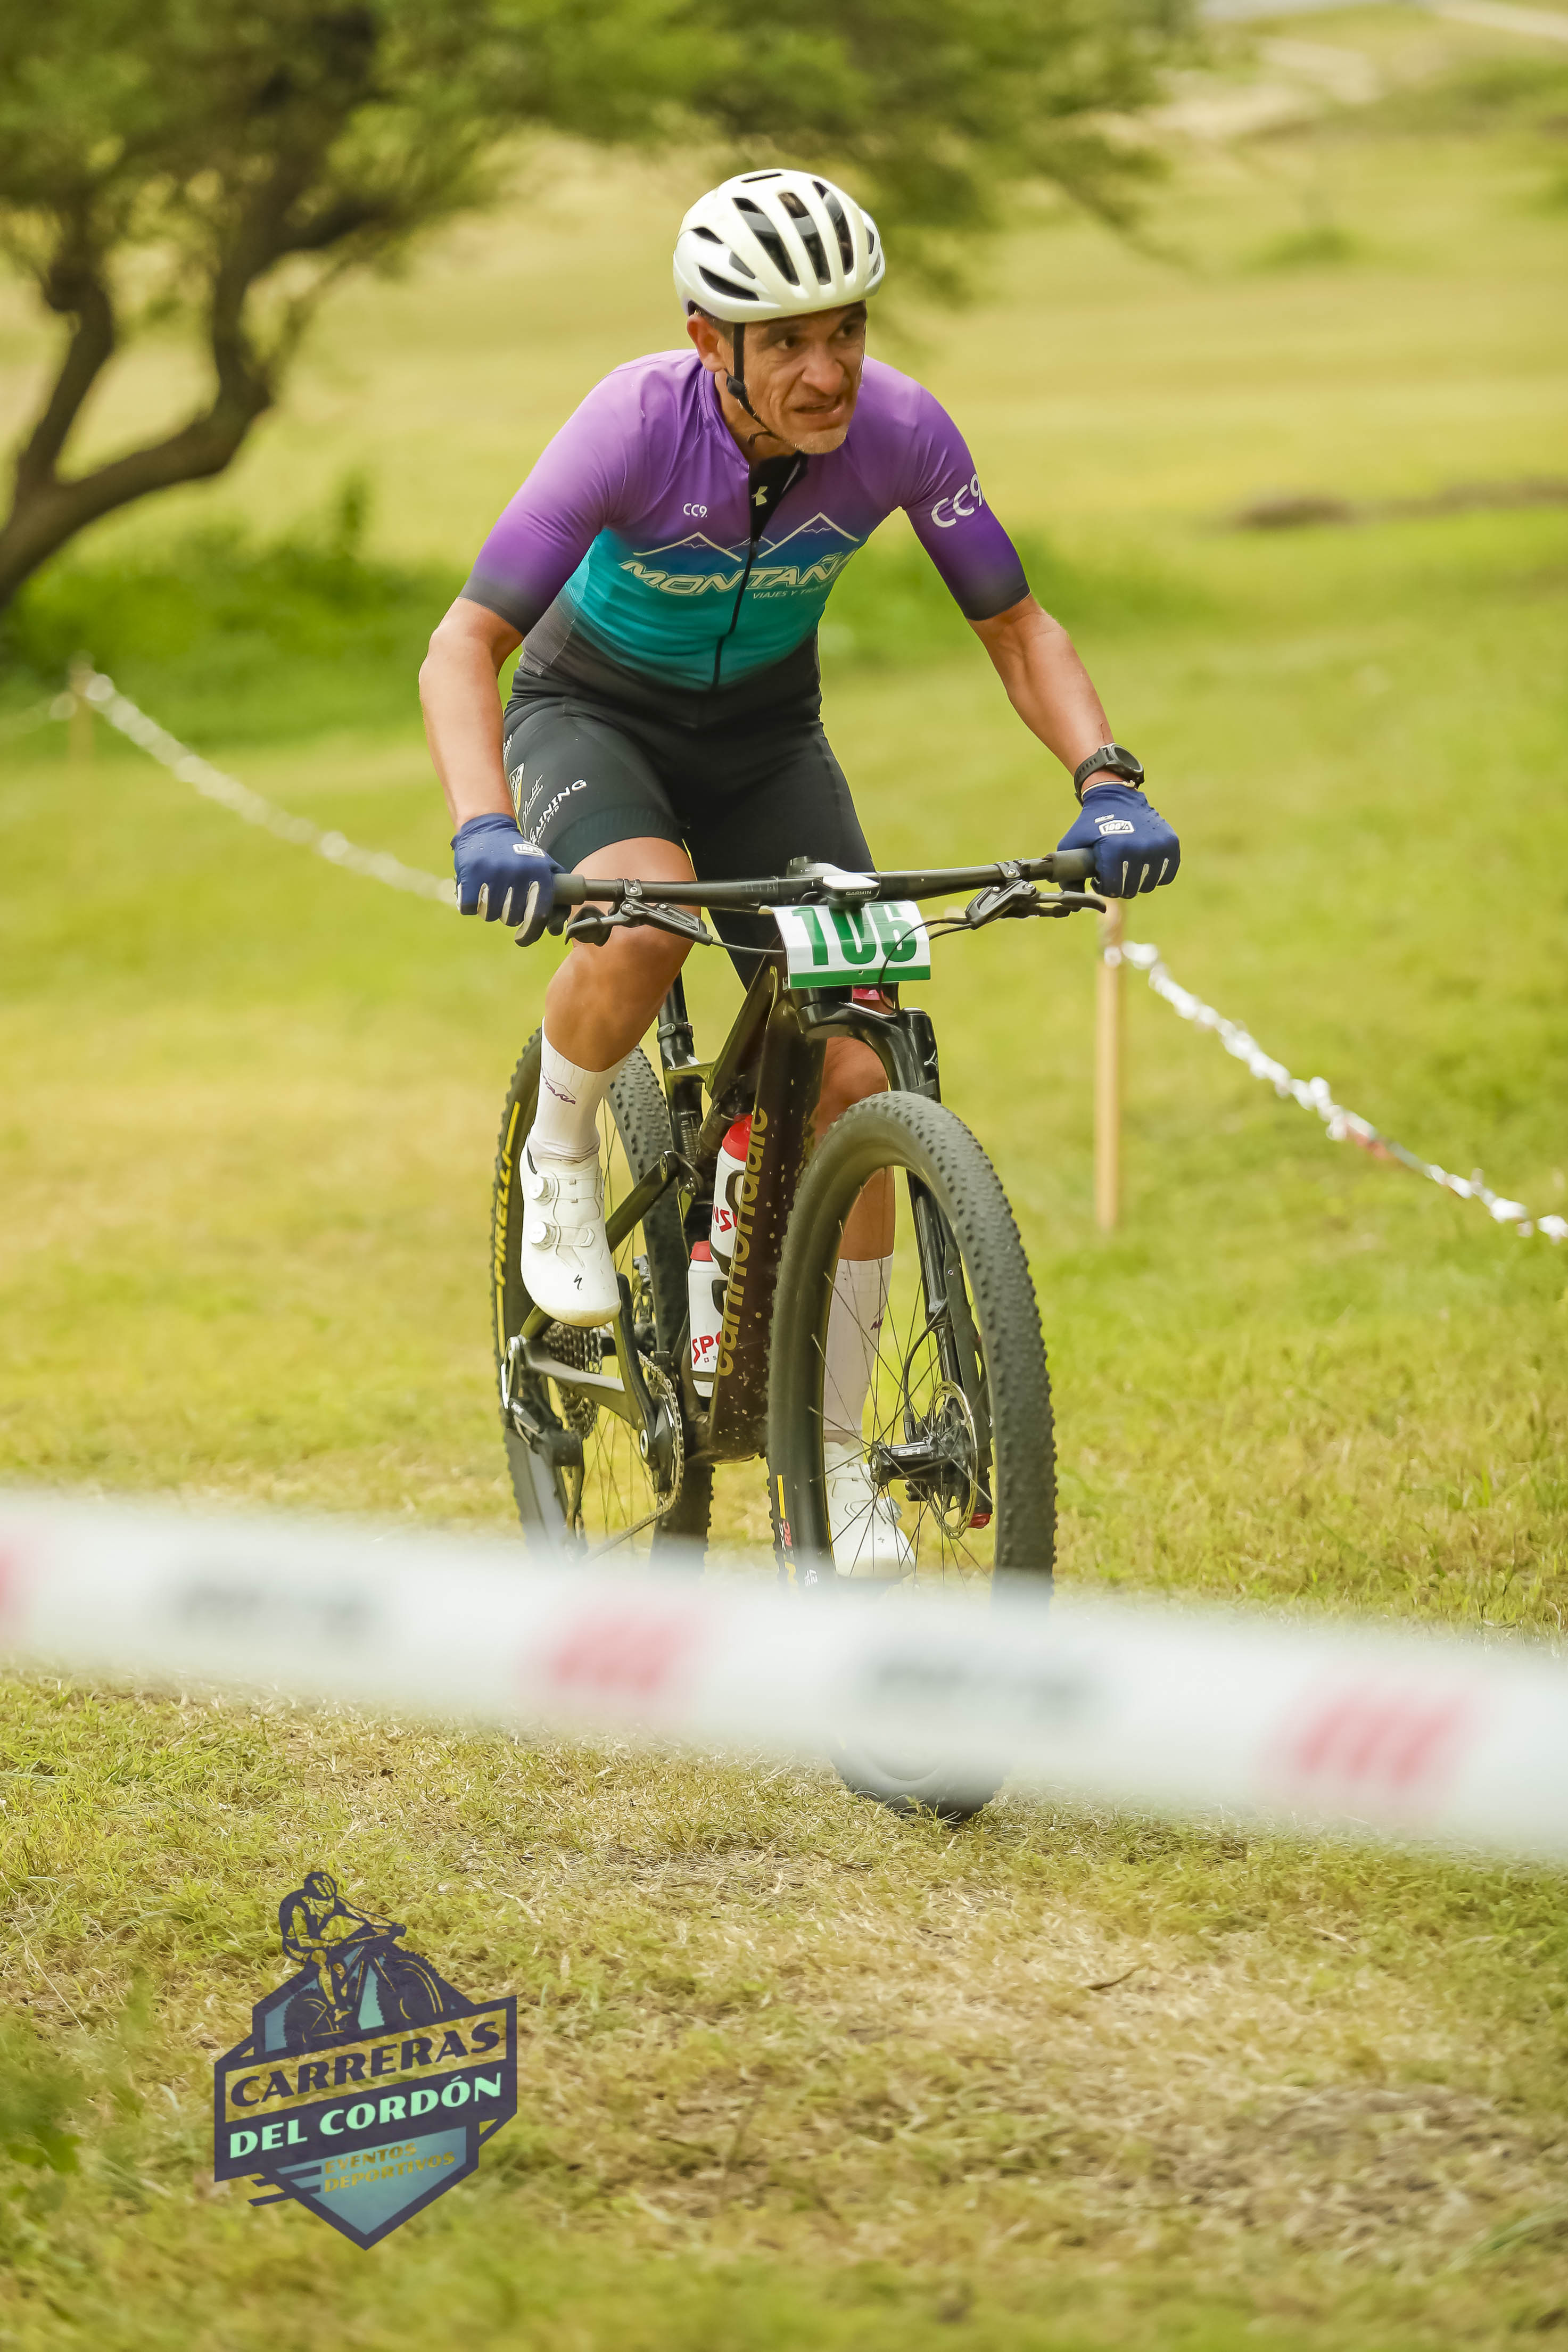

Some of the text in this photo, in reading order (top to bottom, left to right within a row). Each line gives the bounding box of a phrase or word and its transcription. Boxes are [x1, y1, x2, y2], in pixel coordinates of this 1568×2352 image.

[753, 590, 788, 599] VIAJES
[791, 905, 917, 966] 106
[494, 1150, 513, 1287] PIRELLI
